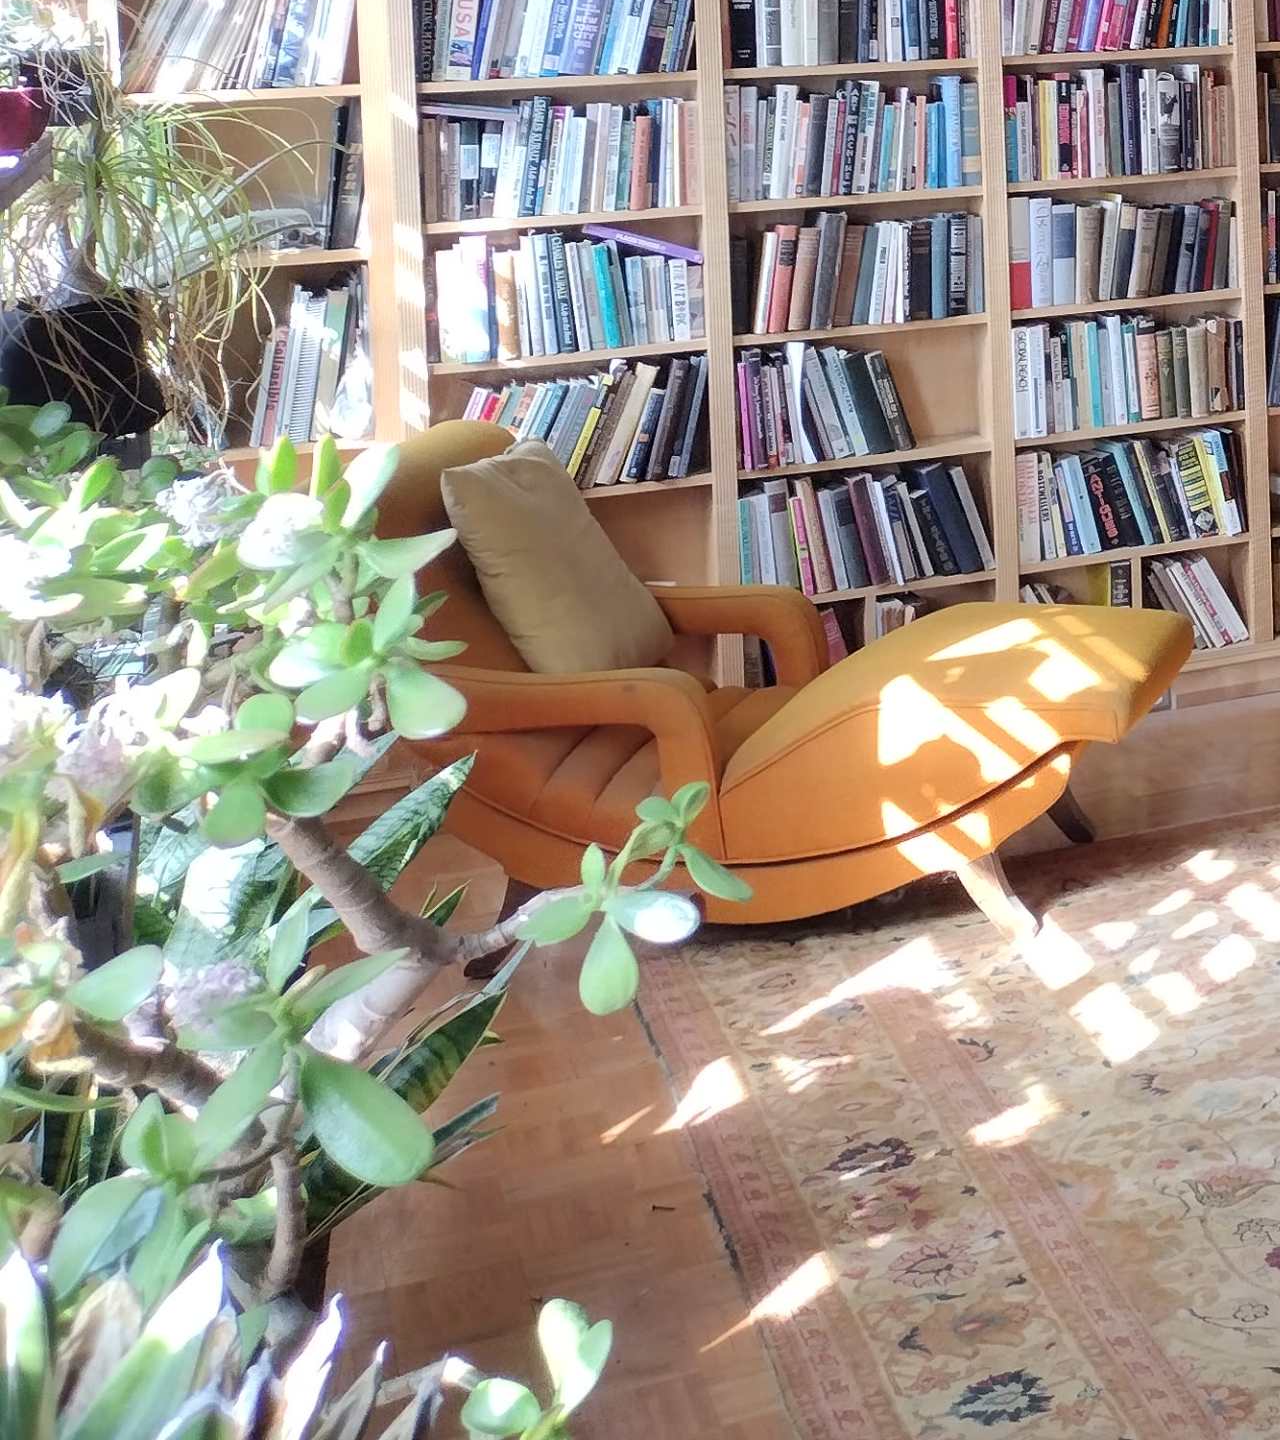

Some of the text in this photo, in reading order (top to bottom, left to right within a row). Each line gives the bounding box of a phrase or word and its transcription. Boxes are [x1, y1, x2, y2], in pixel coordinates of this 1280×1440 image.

[530, 98, 546, 132] CHARLES
[550, 236, 566, 269] CHARLES
[266, 339, 286, 410] Collapsible
